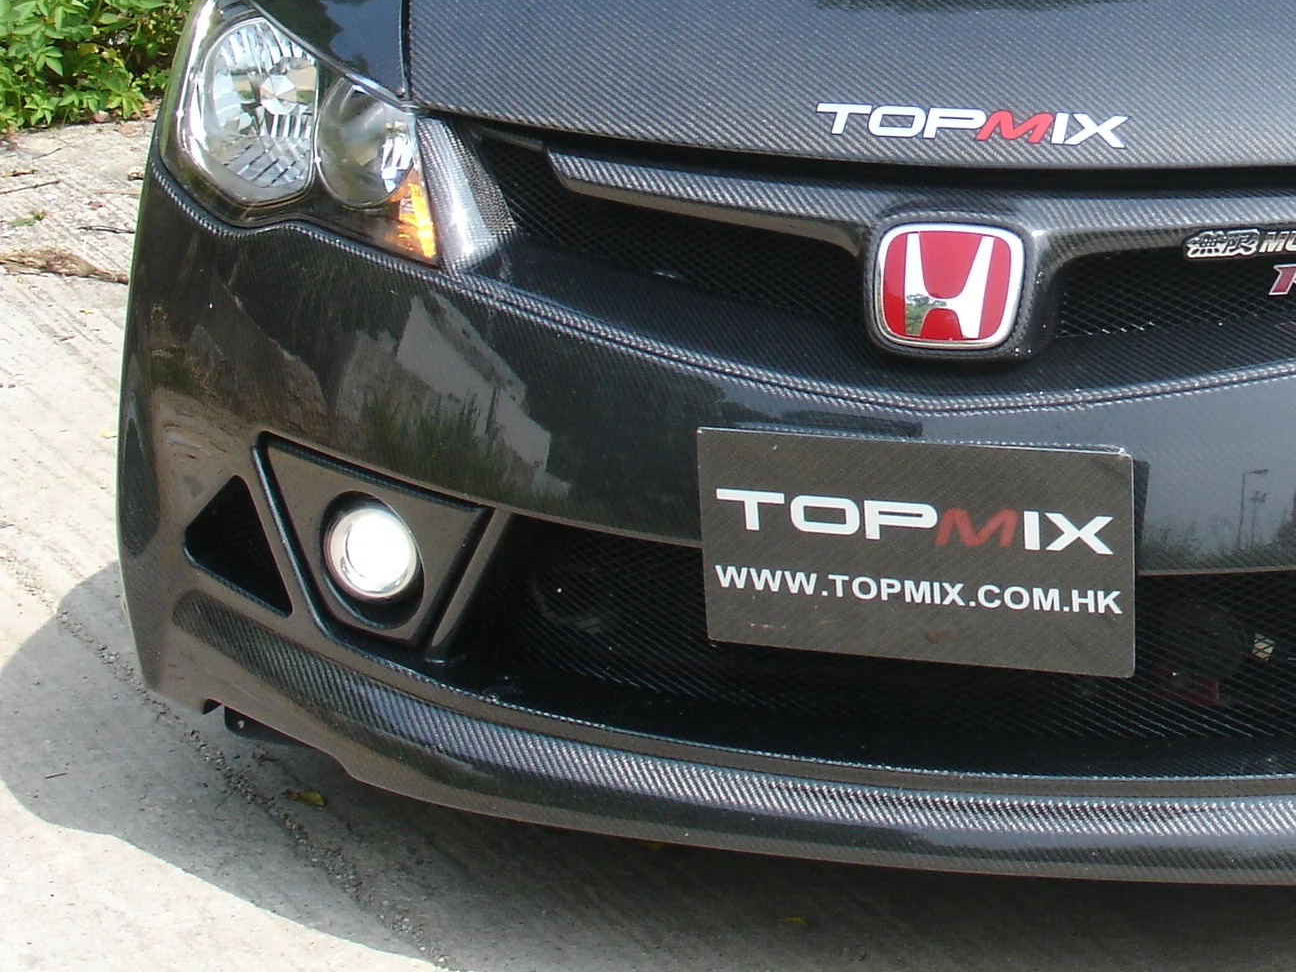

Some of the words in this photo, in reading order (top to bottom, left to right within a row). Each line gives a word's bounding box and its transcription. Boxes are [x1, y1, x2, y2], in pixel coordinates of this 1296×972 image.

[816, 102, 1131, 149] TOPMIX
[715, 488, 1114, 555] TOPMIX
[714, 564, 1123, 615] WWW.TOPMIX.COM.HK
